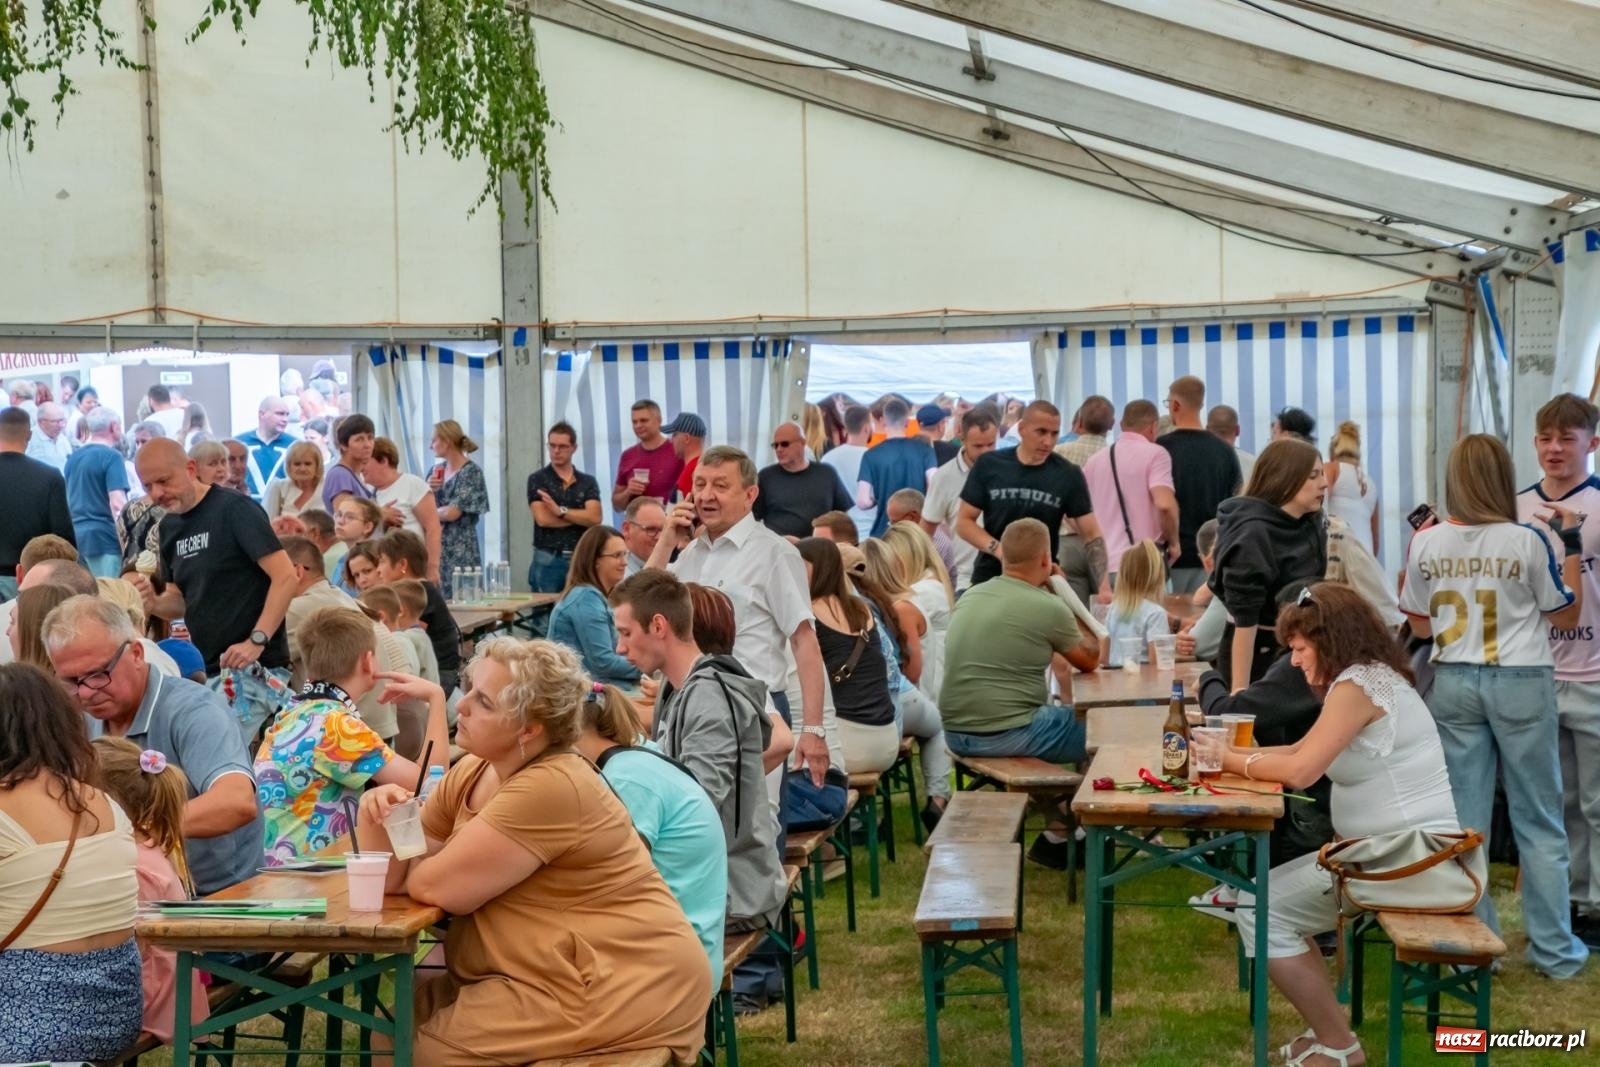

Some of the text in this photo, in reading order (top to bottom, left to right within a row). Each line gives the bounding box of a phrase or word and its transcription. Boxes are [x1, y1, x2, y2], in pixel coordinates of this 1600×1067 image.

[989, 487, 1061, 508] PITBULL
[176, 532, 209, 555] THE CREW
[1418, 557, 1521, 581] SARAPATA
[1429, 589, 1500, 665] 21
